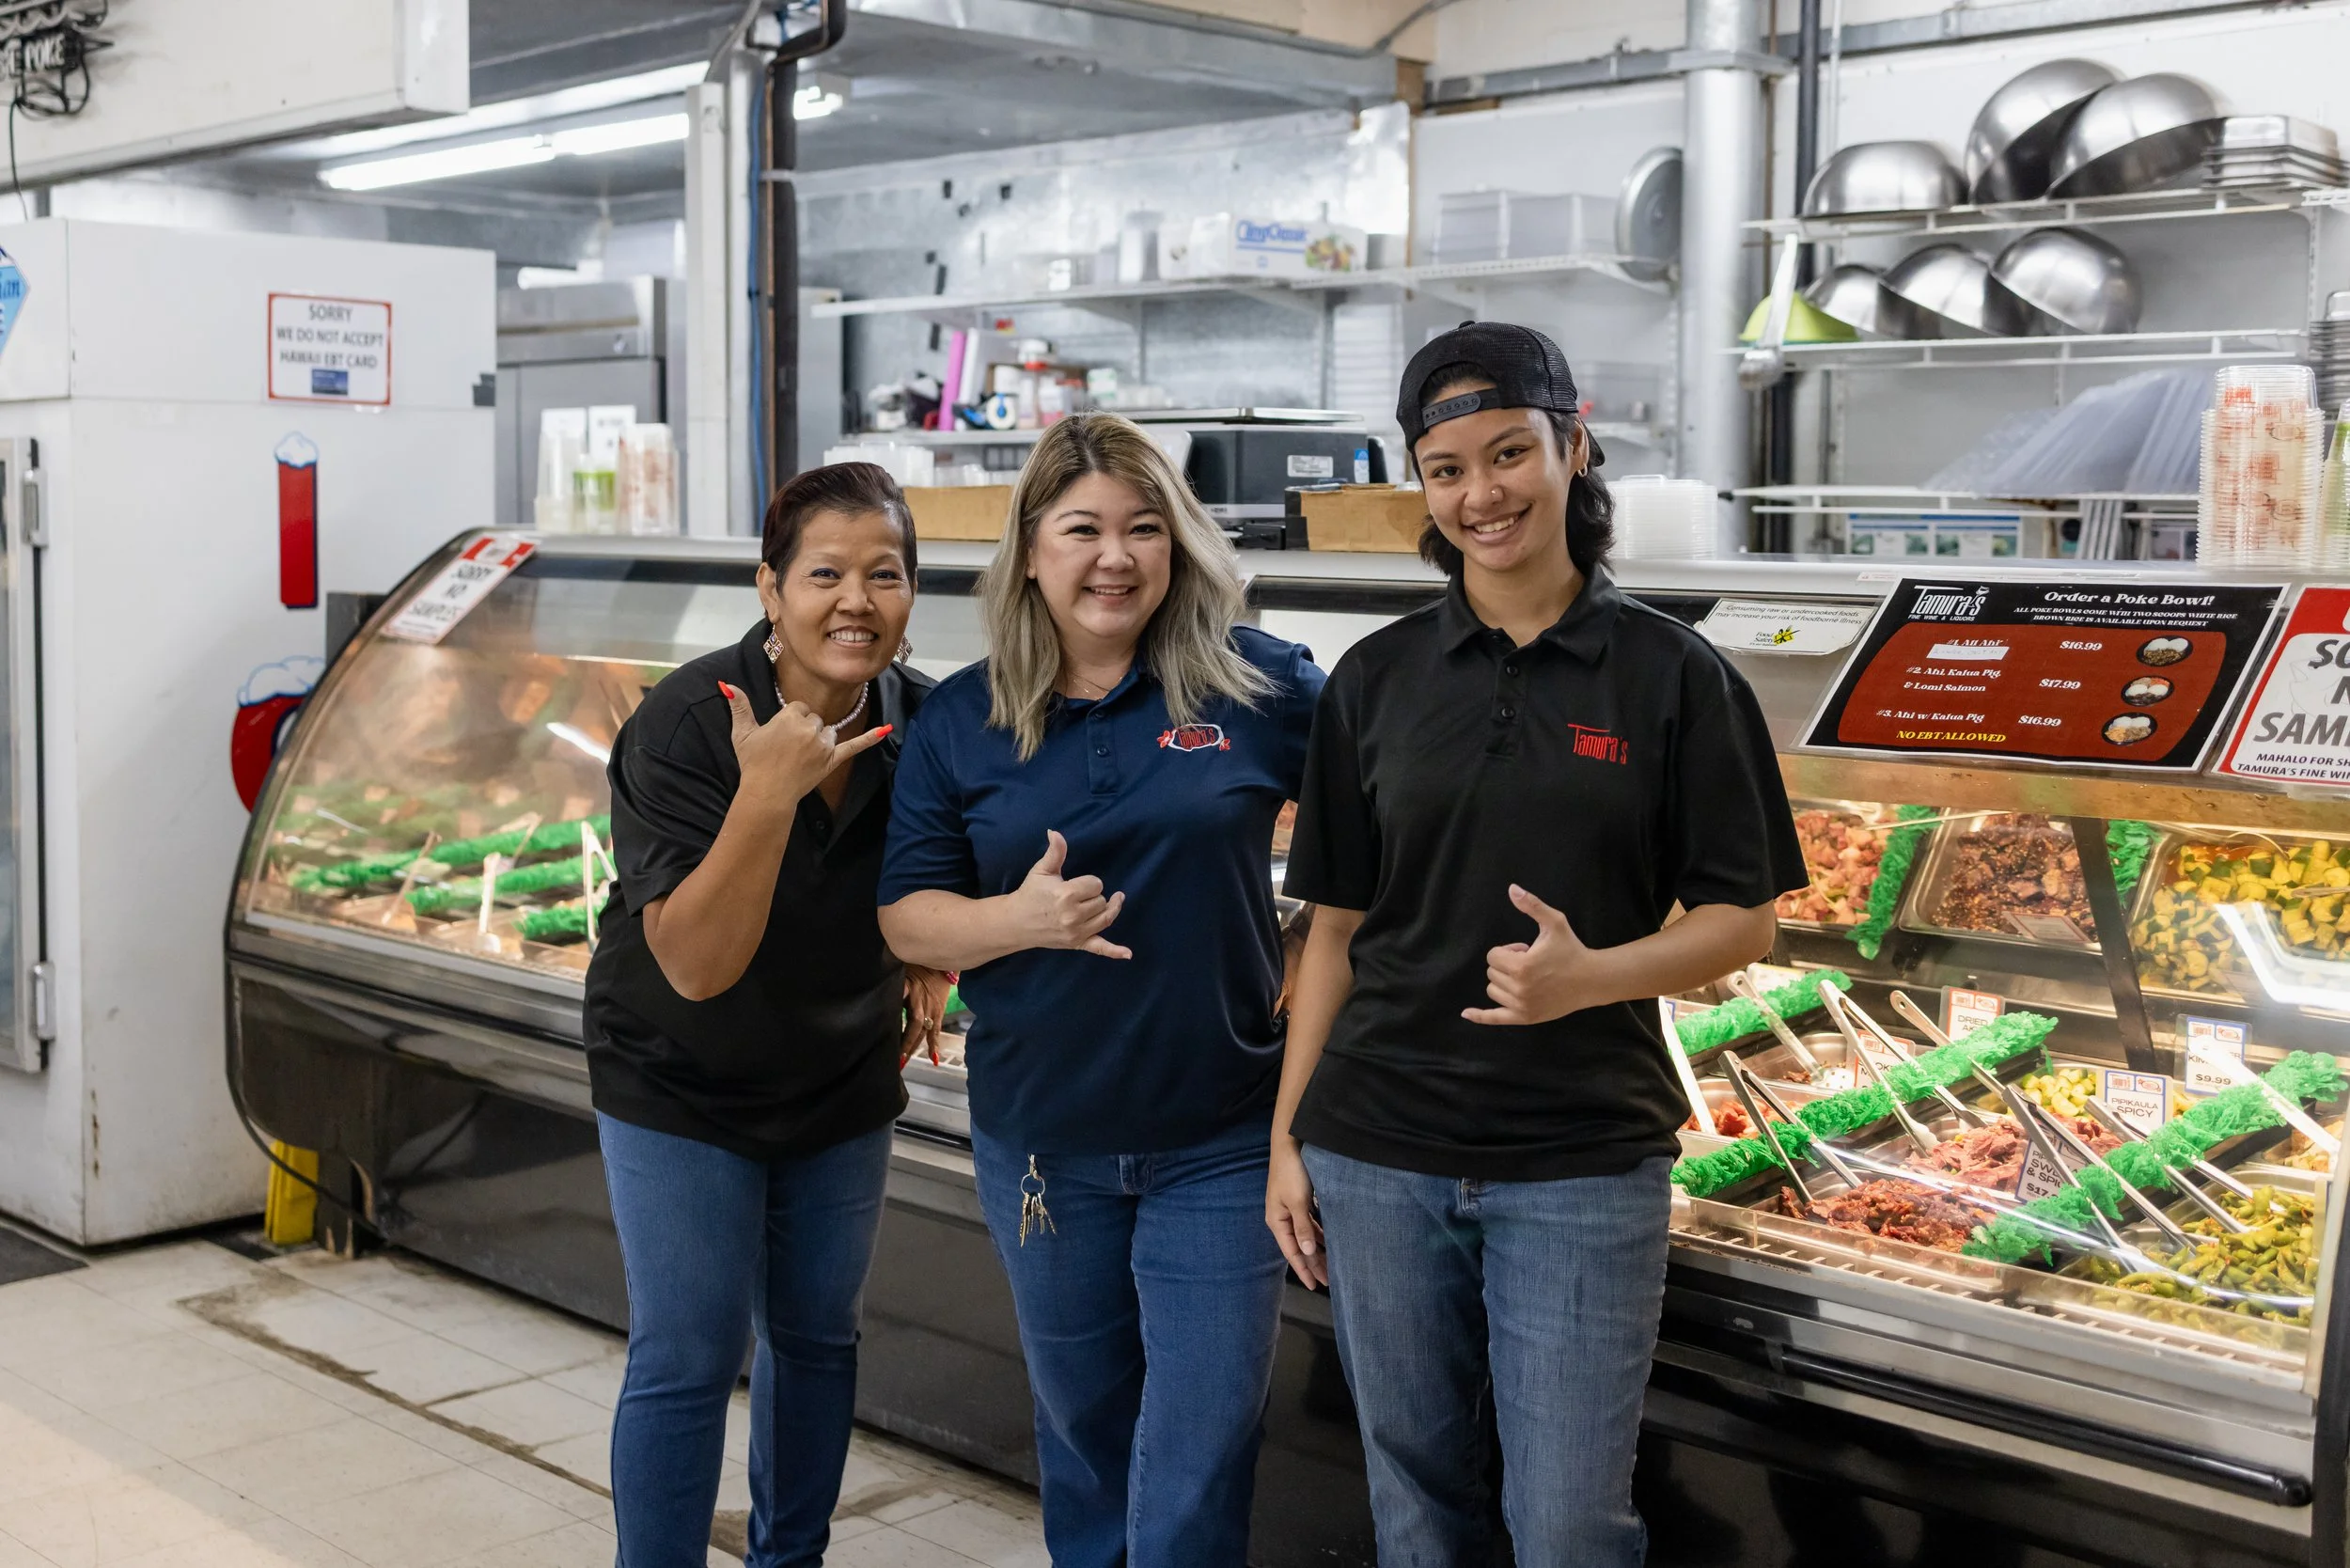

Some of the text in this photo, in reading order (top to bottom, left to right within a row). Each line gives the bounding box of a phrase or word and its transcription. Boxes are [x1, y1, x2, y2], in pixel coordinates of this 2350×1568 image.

[309, 303, 353, 321] SORRY
[276, 326, 384, 347] WE DO NOT ACCEPT
[346, 354, 378, 368] CARD
[1911, 585, 1988, 616] Tamura's
[2044, 591, 2099, 602] Order
[2114, 593, 2159, 604] Poke
[2160, 594, 2216, 606] Bowl!
[1726, 604, 1766, 613] Consuming
[2059, 640, 2103, 651] $16.99
[1914, 682, 1943, 691] Lomi
[2039, 678, 2081, 689] $17.99
[1894, 711, 1915, 719] Ahi
[1931, 713, 1964, 721] Kalua
[1965, 713, 1985, 724] Pig
[2017, 714, 2062, 727] $16.99
[2253, 712, 2350, 747] SAM
[1897, 730, 2006, 743] NO EBT ALLOWED
[1567, 723, 1628, 764] Tamura's
[2256, 753, 2307, 764] MAHALO
[2310, 756, 2334, 766] FOR
[2237, 762, 2296, 776] TAMURA'S
[2299, 768, 2326, 778] FINE
[1957, 1014, 1988, 1026] DRIED
[2196, 1074, 2232, 1086] $9.99
[2111, 1097, 2159, 1109] PIPIKAULA
[2117, 1105, 2154, 1118] SPICY
[2026, 1167, 2035, 1177] &
